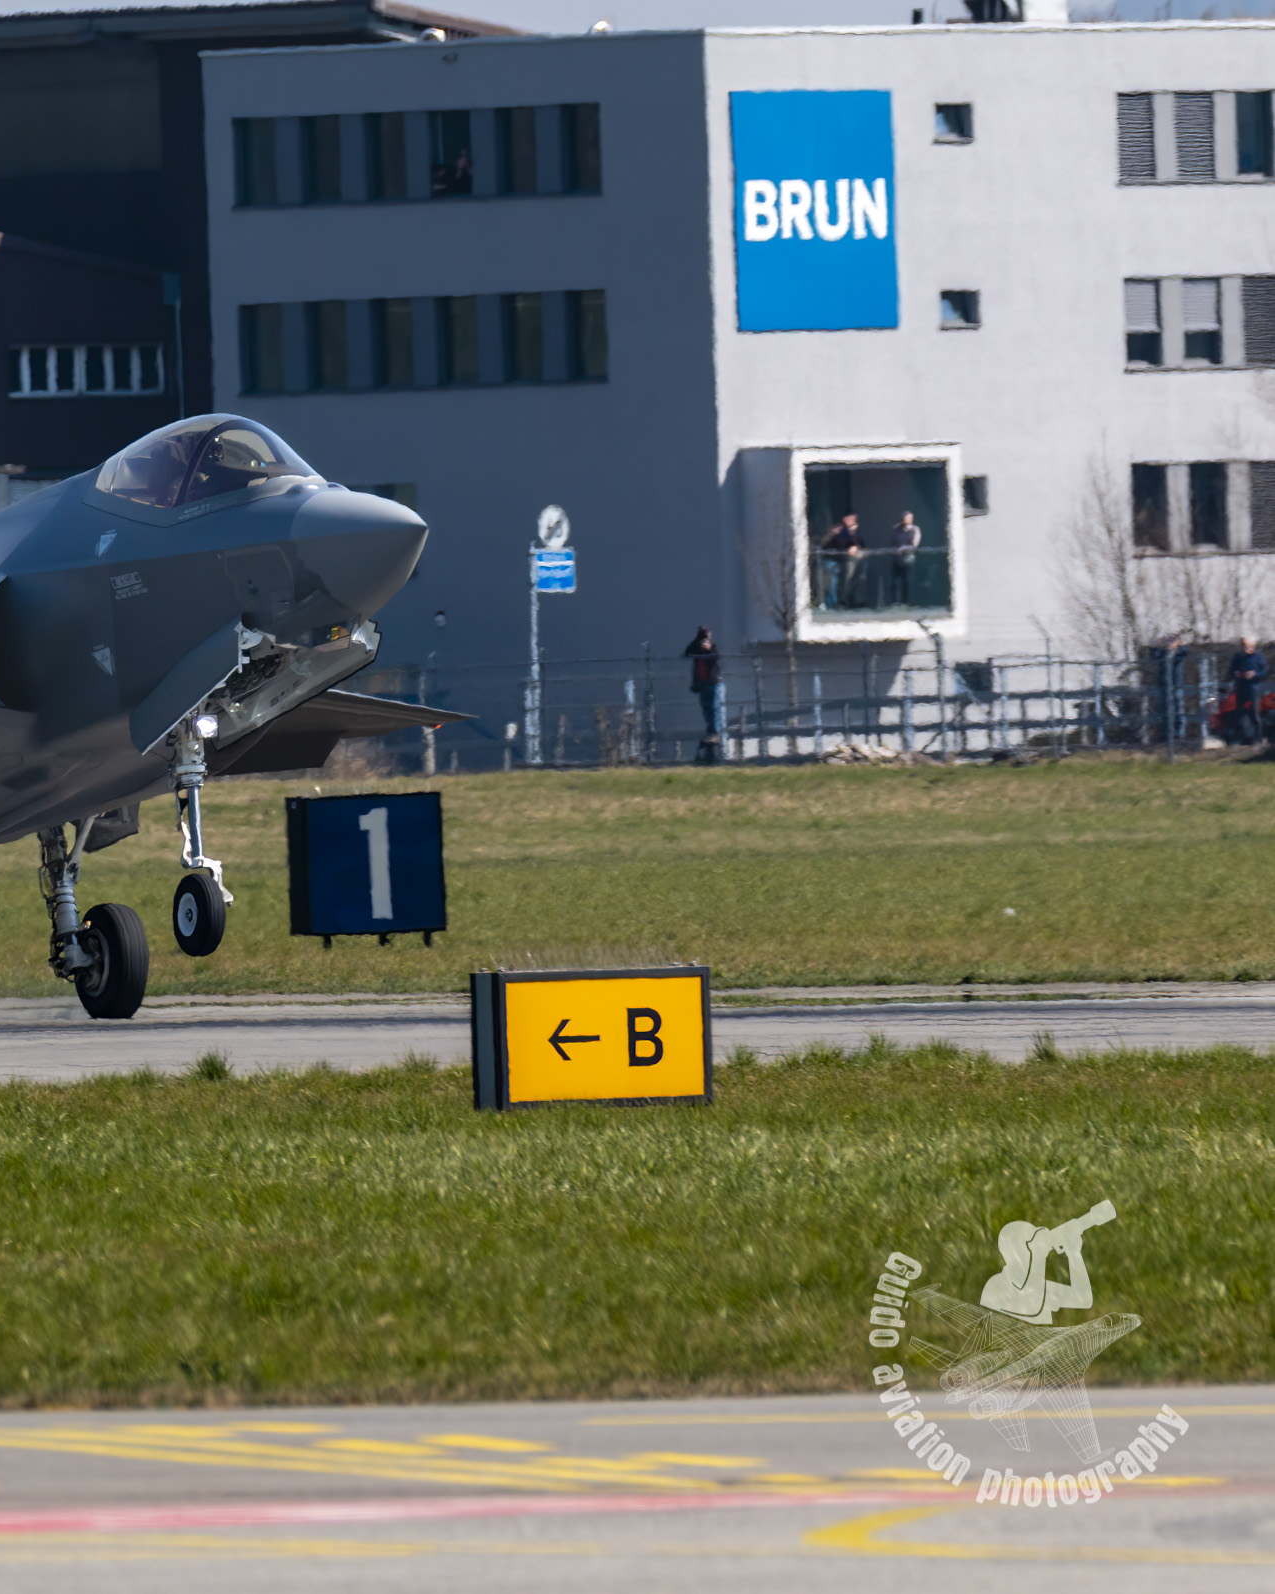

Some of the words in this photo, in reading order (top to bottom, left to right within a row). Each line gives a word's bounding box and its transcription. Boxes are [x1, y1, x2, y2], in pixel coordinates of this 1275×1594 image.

[743, 177, 888, 242] BRUN
[358, 807, 393, 920] 1
[626, 1007, 663, 1067] B
